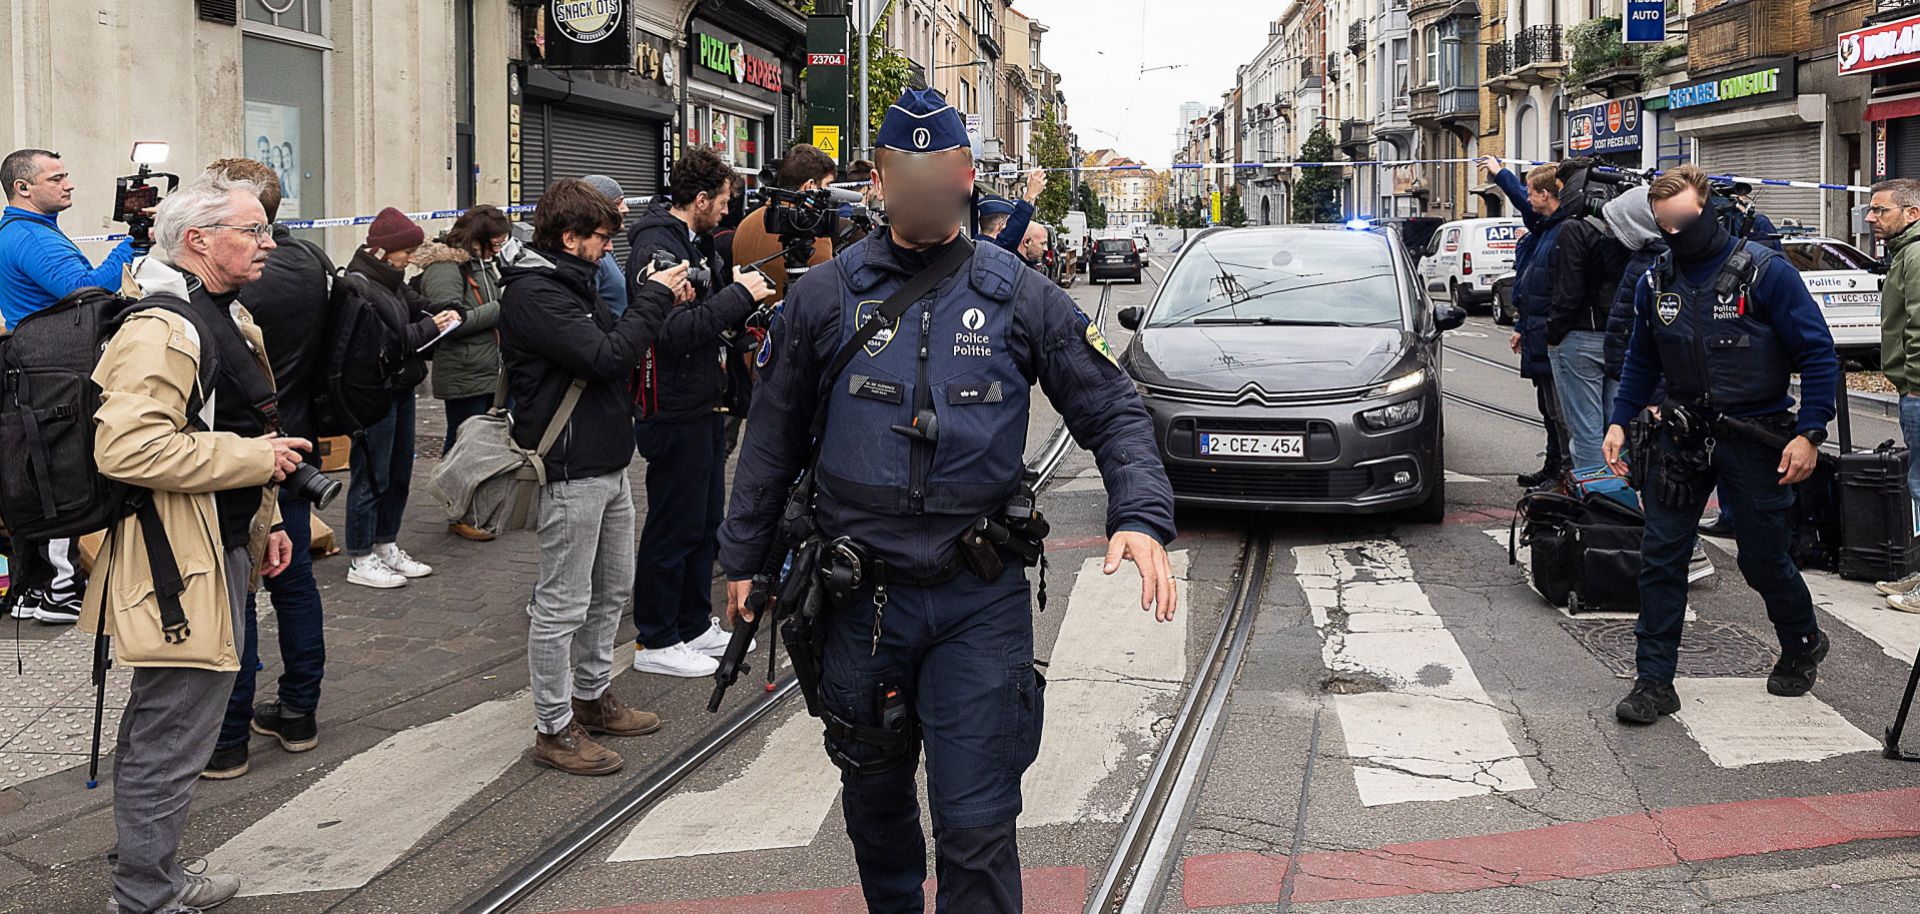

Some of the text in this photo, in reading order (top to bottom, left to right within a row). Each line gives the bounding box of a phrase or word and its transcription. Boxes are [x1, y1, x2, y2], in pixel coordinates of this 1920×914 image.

[557, 1, 594, 21] SNACK
[1632, 10, 1660, 20] AUTO
[700, 32, 782, 93] PIZZA EXPRESS
[812, 55, 841, 65] 23704
[1668, 68, 1779, 110] FISCABEL CONSULT
[1594, 139, 1607, 149] OOST
[1624, 134, 1638, 145] AUTO
[663, 121, 671, 187] NACK
[1488, 227, 1515, 240] API
[1809, 279, 1841, 287] Politie
[1713, 304, 1737, 312] Police
[1713, 312, 1740, 320] Politie
[955, 331, 990, 344] Police
[953, 344, 992, 357] Politie
[1210, 437, 1300, 453] 2-CEZ-454
